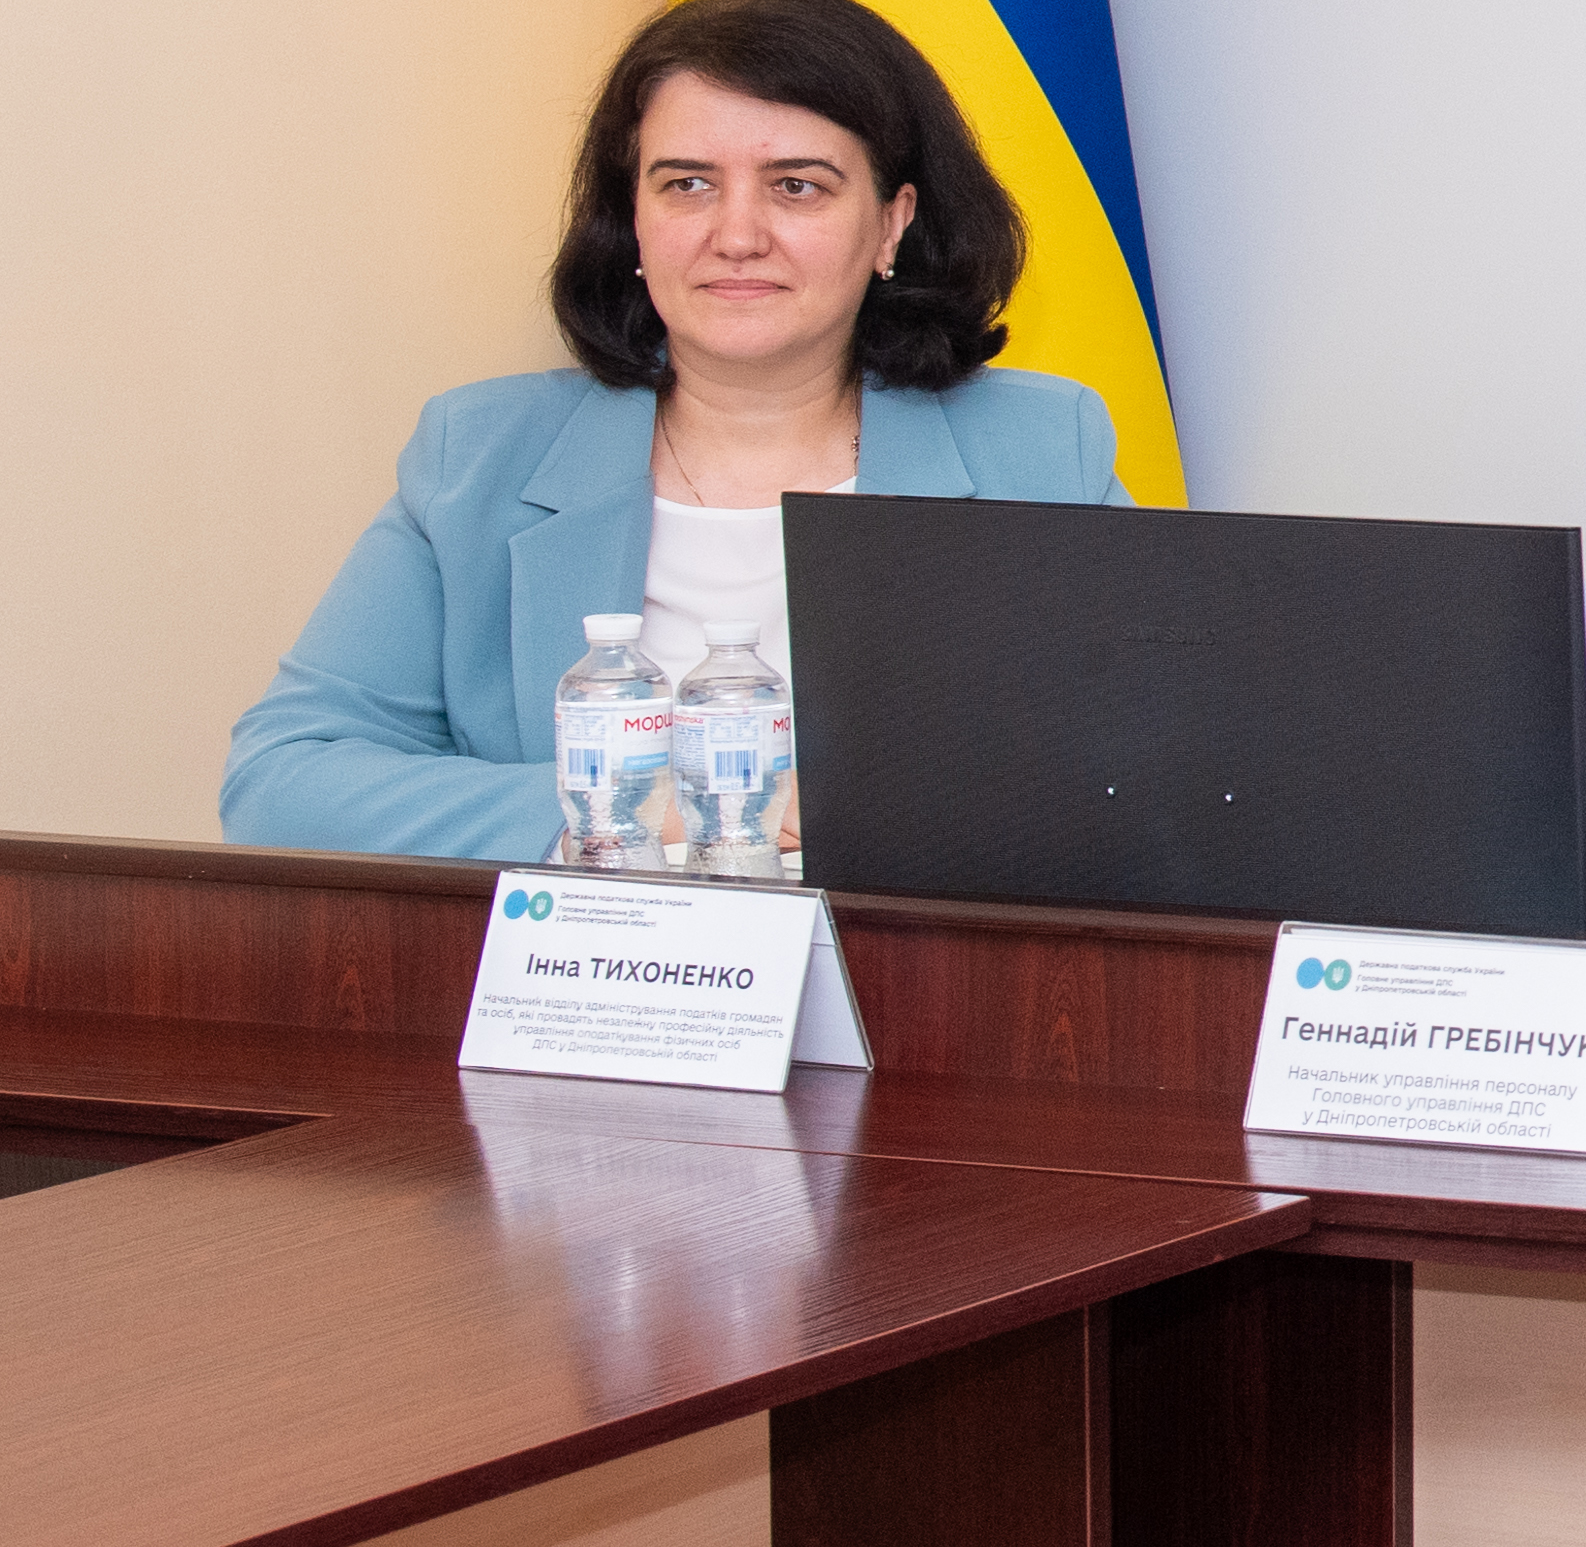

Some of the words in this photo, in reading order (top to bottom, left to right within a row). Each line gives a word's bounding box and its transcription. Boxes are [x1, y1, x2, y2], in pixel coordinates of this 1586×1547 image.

[560, 892, 595, 900] Державна
[598, 895, 634, 903] податкова
[636, 898, 662, 906] служба
[561, 915, 628, 925] Дніпропетровській
[526, 953, 580, 977] Інна
[591, 957, 754, 989] ТИХОНЕНКО
[477, 1008, 487, 1016] та
[491, 1009, 515, 1020] осіб,
[518, 1011, 534, 1020] які
[537, 1012, 592, 1024] провадять
[596, 1017, 656, 1031] незалежну
[659, 1021, 725, 1035] професійну
[727, 1026, 784, 1039] діяльність
[483, 993, 541, 1006] Начальник
[545, 998, 583, 1011] відділу
[585, 1002, 676, 1016] адміністрування
[679, 1009, 726, 1020] податків
[729, 1012, 783, 1024] громадян
[513, 1025, 574, 1036] управління
[577, 1029, 660, 1043] оподаткування
[663, 1035, 714, 1047] фізичних
[718, 1039, 741, 1049] осіб
[1282, 1016, 1417, 1049] Геннадій
[532, 1039, 556, 1050] ДПС
[559, 1043, 566, 1052] у
[567, 1041, 673, 1058] Дніпропетровській
[676, 1051, 718, 1062] області
[1288, 1065, 1378, 1084] Начальник
[1383, 1074, 1480, 1092] управління
[1485, 1080, 1578, 1100] персоналу
[1312, 1087, 1402, 1107] Головного
[1405, 1096, 1503, 1114] управління
[1507, 1100, 1546, 1117] ДПС
[1302, 1111, 1313, 1125] у
[1316, 1108, 1481, 1133] Дніпропетровській
[1486, 1120, 1552, 1138] області
